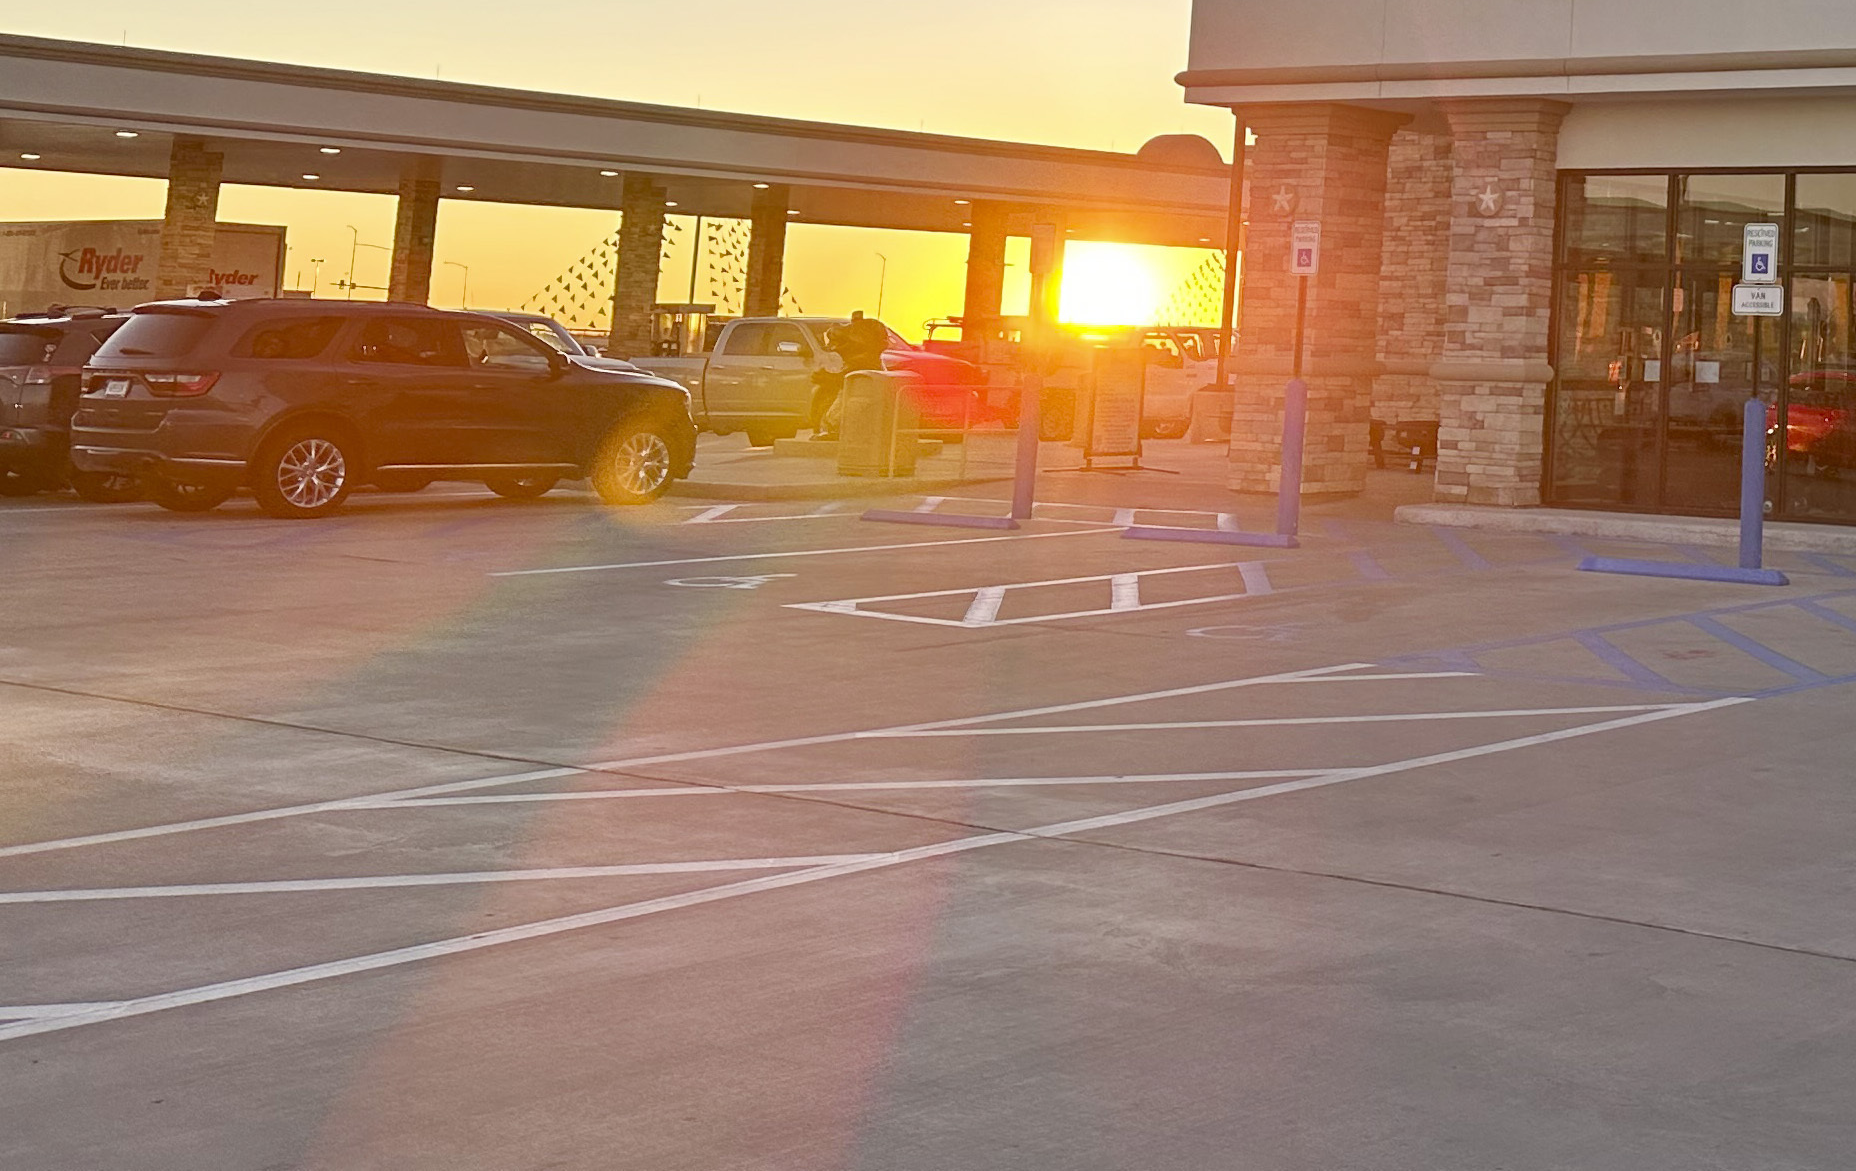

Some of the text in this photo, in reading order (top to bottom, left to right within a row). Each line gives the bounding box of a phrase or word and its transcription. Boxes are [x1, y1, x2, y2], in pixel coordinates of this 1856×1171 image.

[1748, 239, 1773, 248] PARKING
[78, 247, 144, 280] Ryder
[100, 276, 119, 290] Ever
[1751, 292, 1766, 300] VAN
